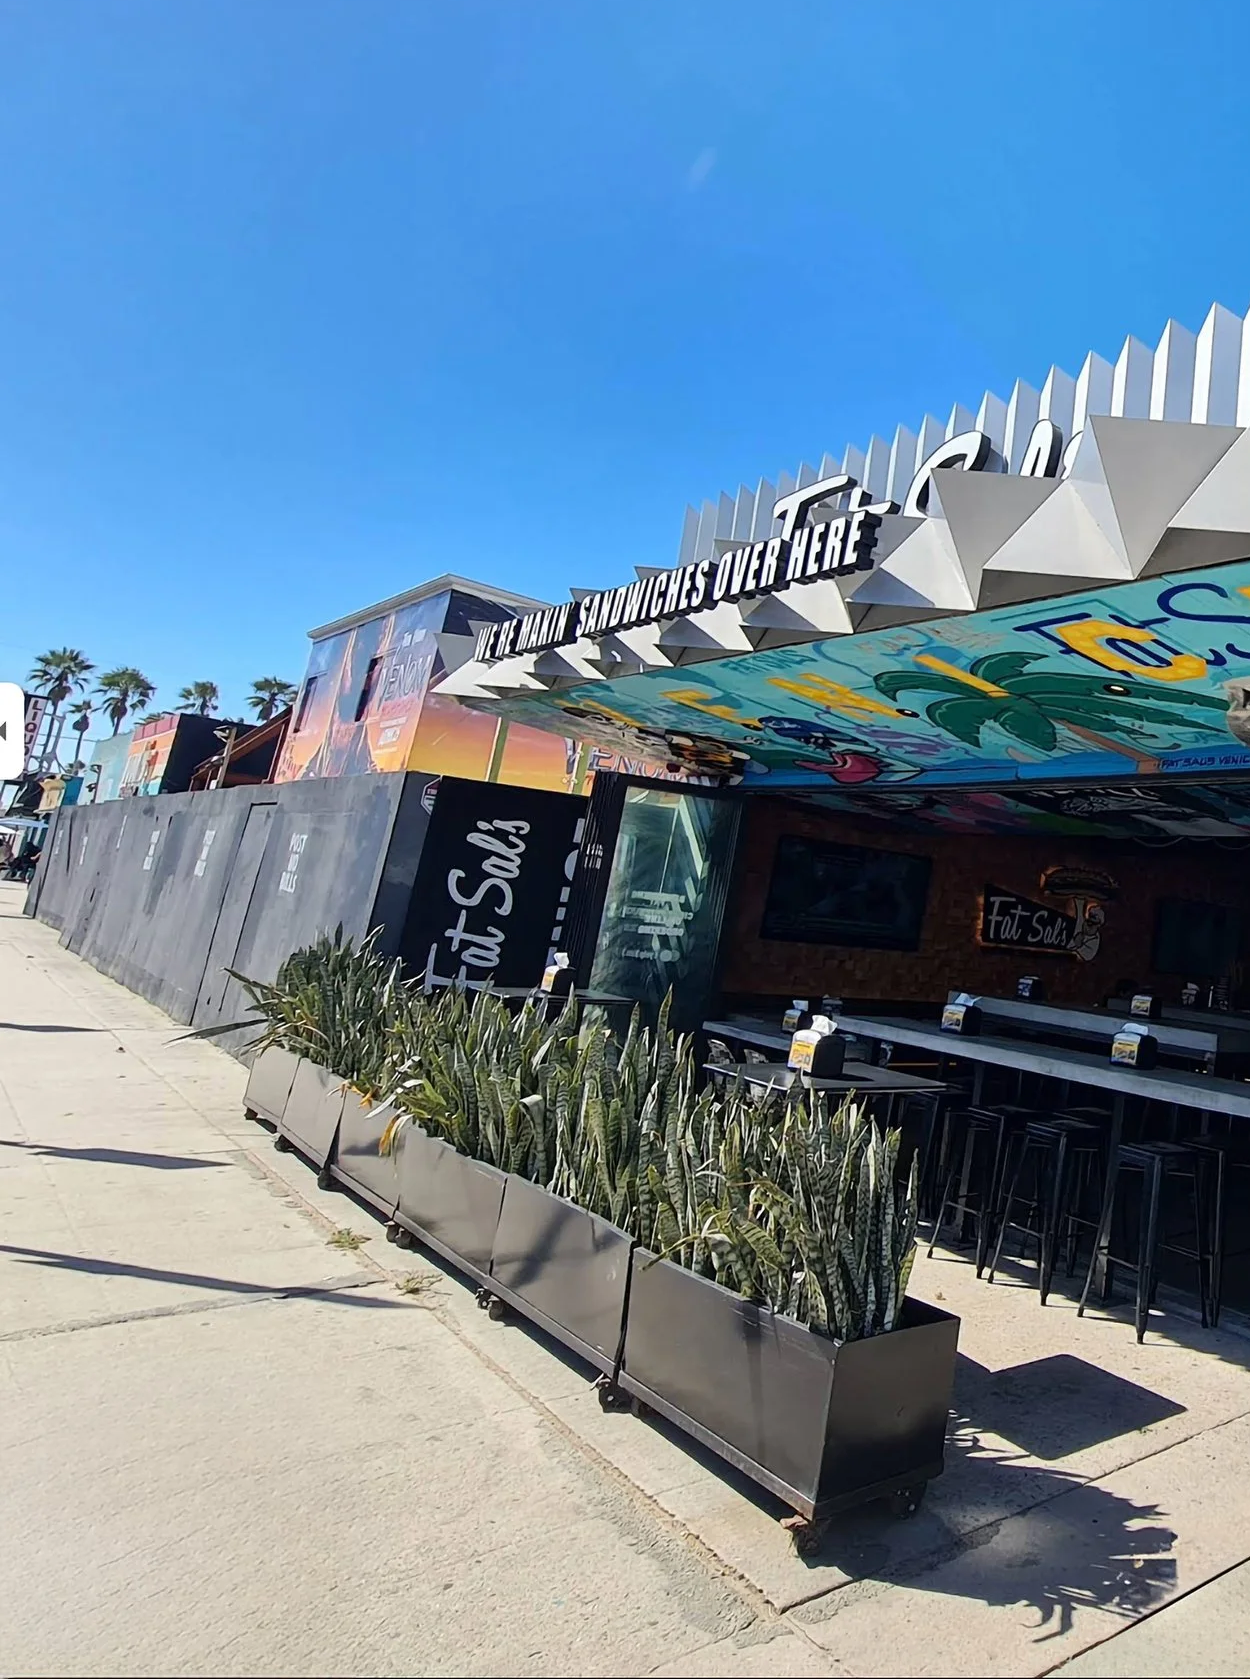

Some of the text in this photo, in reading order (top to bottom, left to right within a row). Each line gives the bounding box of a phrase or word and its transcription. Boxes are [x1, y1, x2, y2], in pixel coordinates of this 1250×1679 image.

[516, 602, 576, 651] MAKIN'
[575, 559, 711, 637] SANDWICHES
[712, 536, 782, 601] OVER
[784, 510, 866, 582] HERE
[288, 832, 308, 853] POST
[423, 819, 530, 996] Fat Sal's
[988, 896, 1067, 946] Fat Sal's
